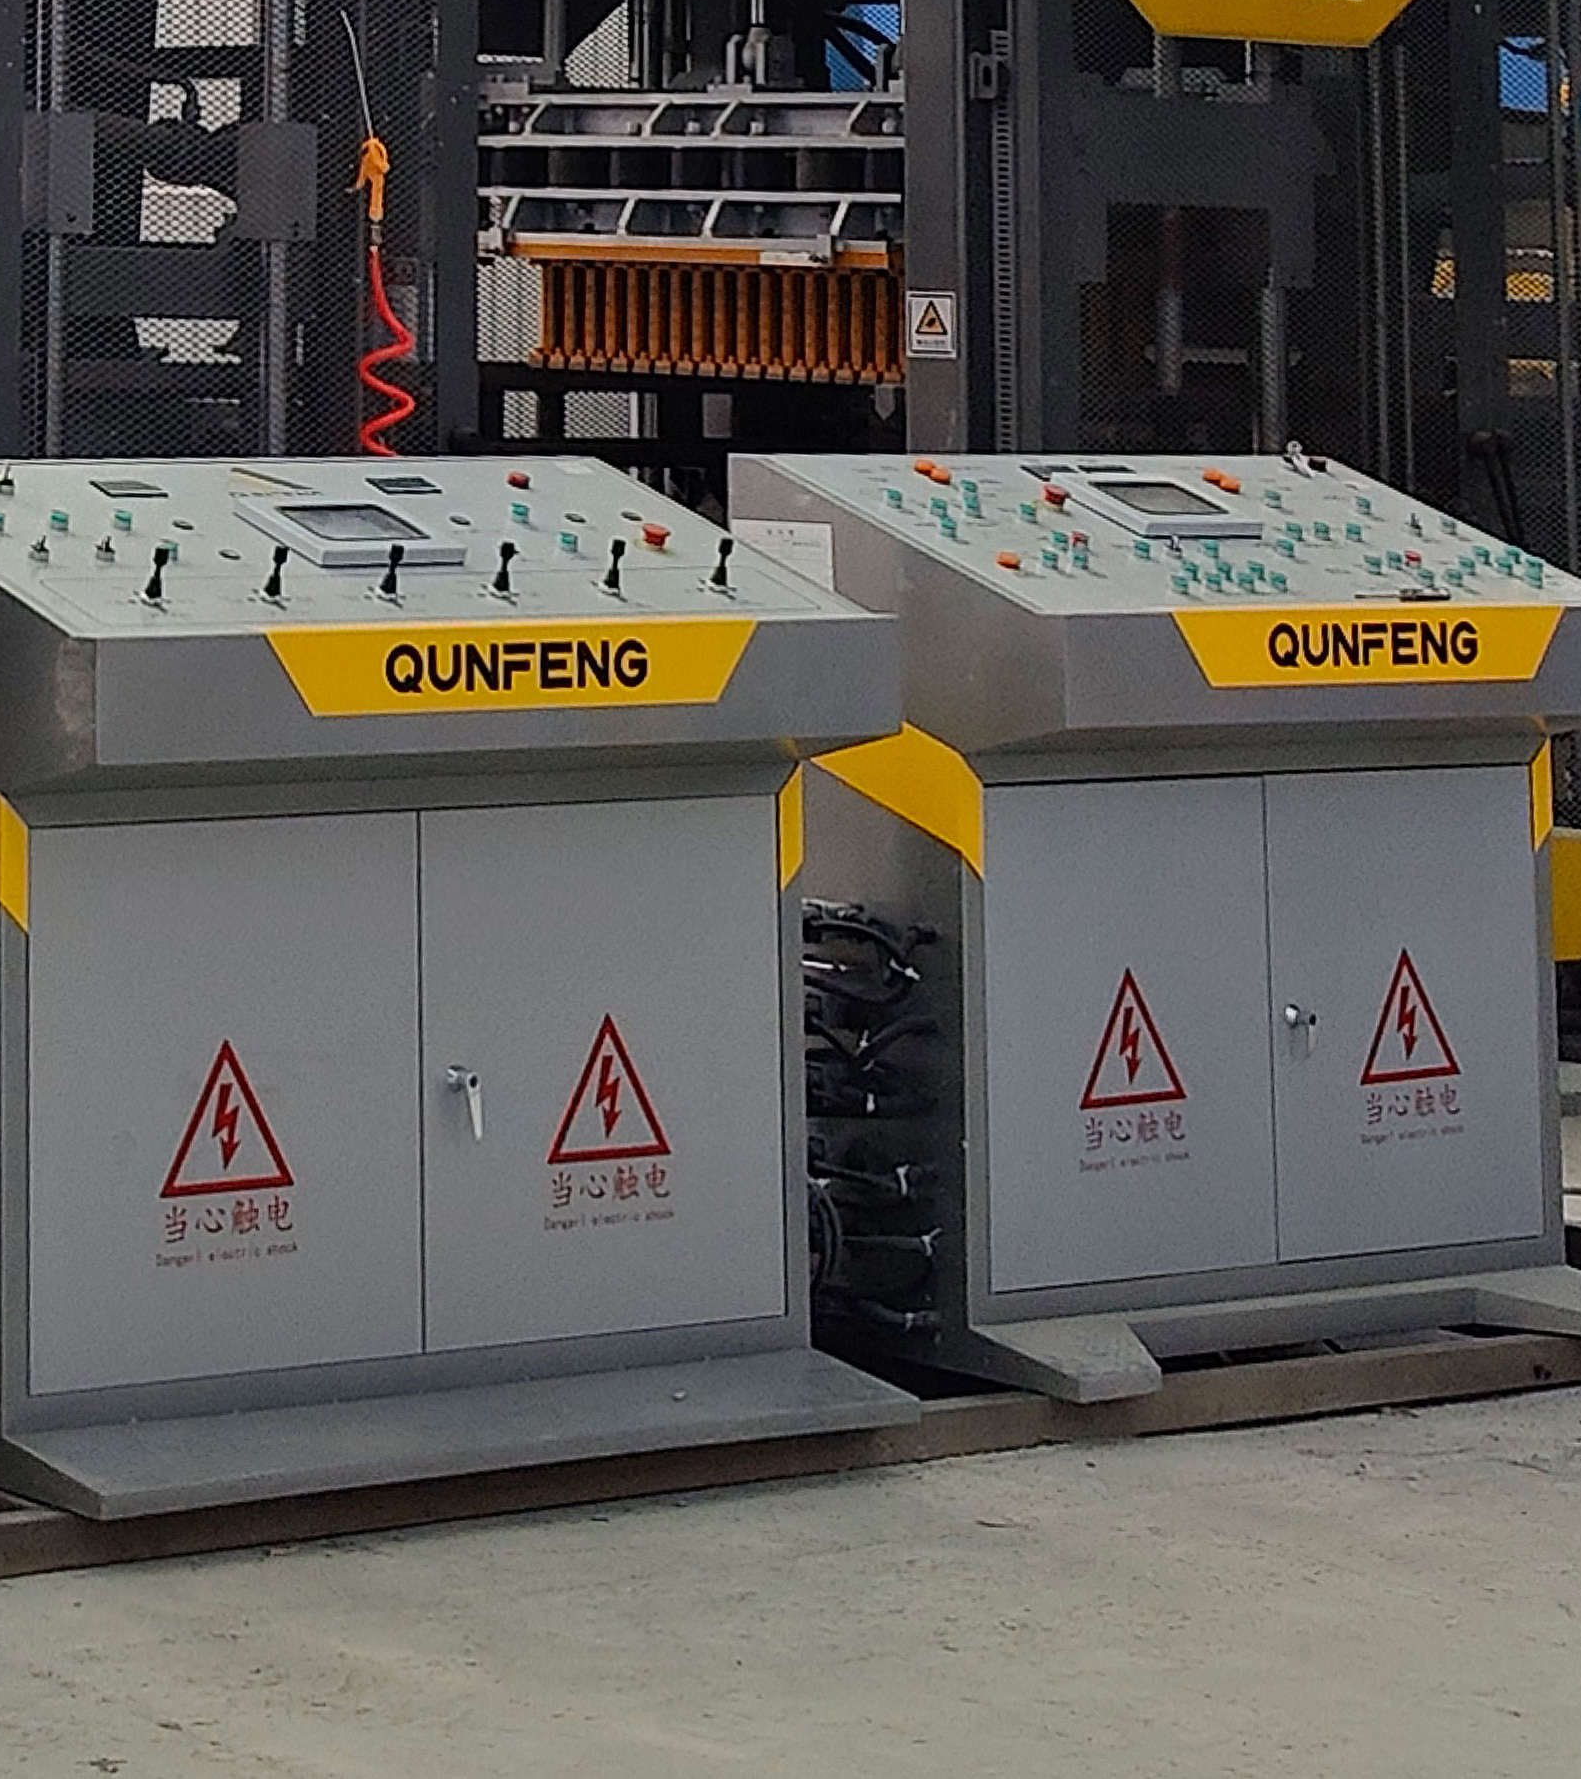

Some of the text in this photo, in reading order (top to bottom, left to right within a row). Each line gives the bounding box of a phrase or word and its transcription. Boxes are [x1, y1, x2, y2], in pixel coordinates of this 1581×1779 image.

[385, 639, 648, 694] QUNFENG
[1268, 621, 1479, 668] QUNFENG
[552, 1163, 670, 1208] 当心触电
[165, 1194, 293, 1243] 当心触电
